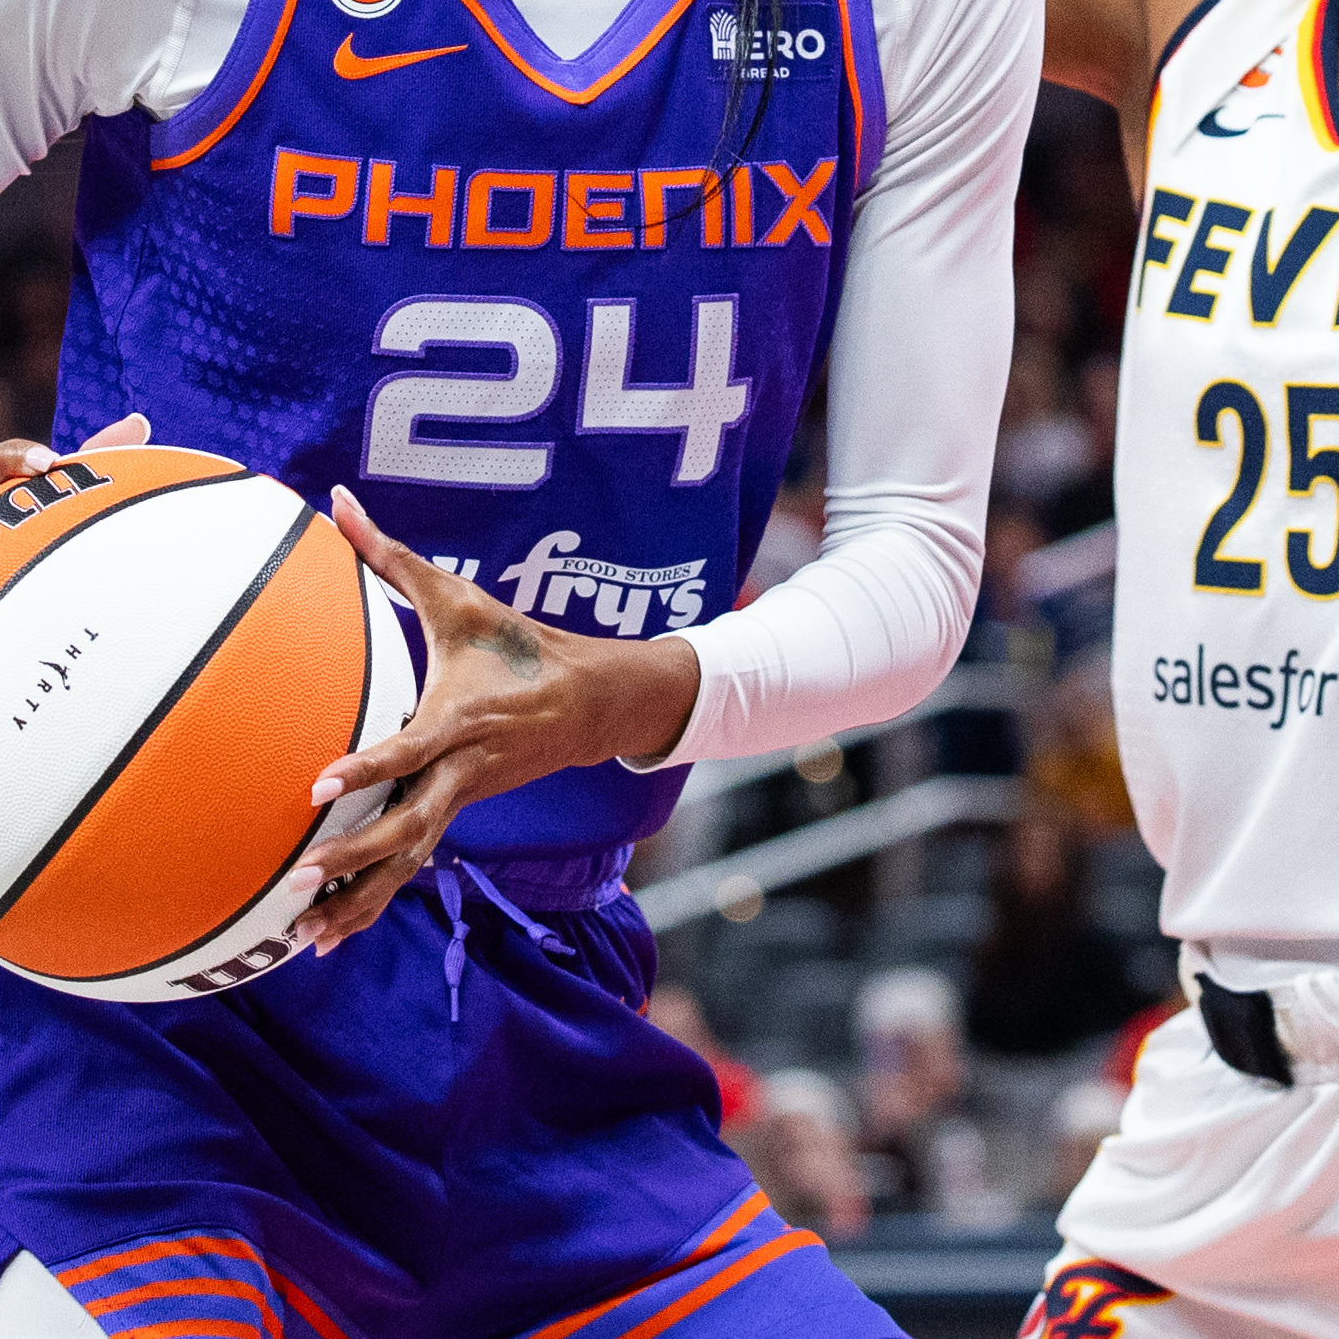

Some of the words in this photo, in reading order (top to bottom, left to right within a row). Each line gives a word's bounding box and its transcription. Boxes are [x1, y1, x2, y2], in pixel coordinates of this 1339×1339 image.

[710, 9, 825, 60] HERO
[268, 145, 838, 250] PHOENIX
[360, 292, 753, 490] 24
[562, 558, 617, 578] FOOD
[624, 564, 692, 584] STORES
